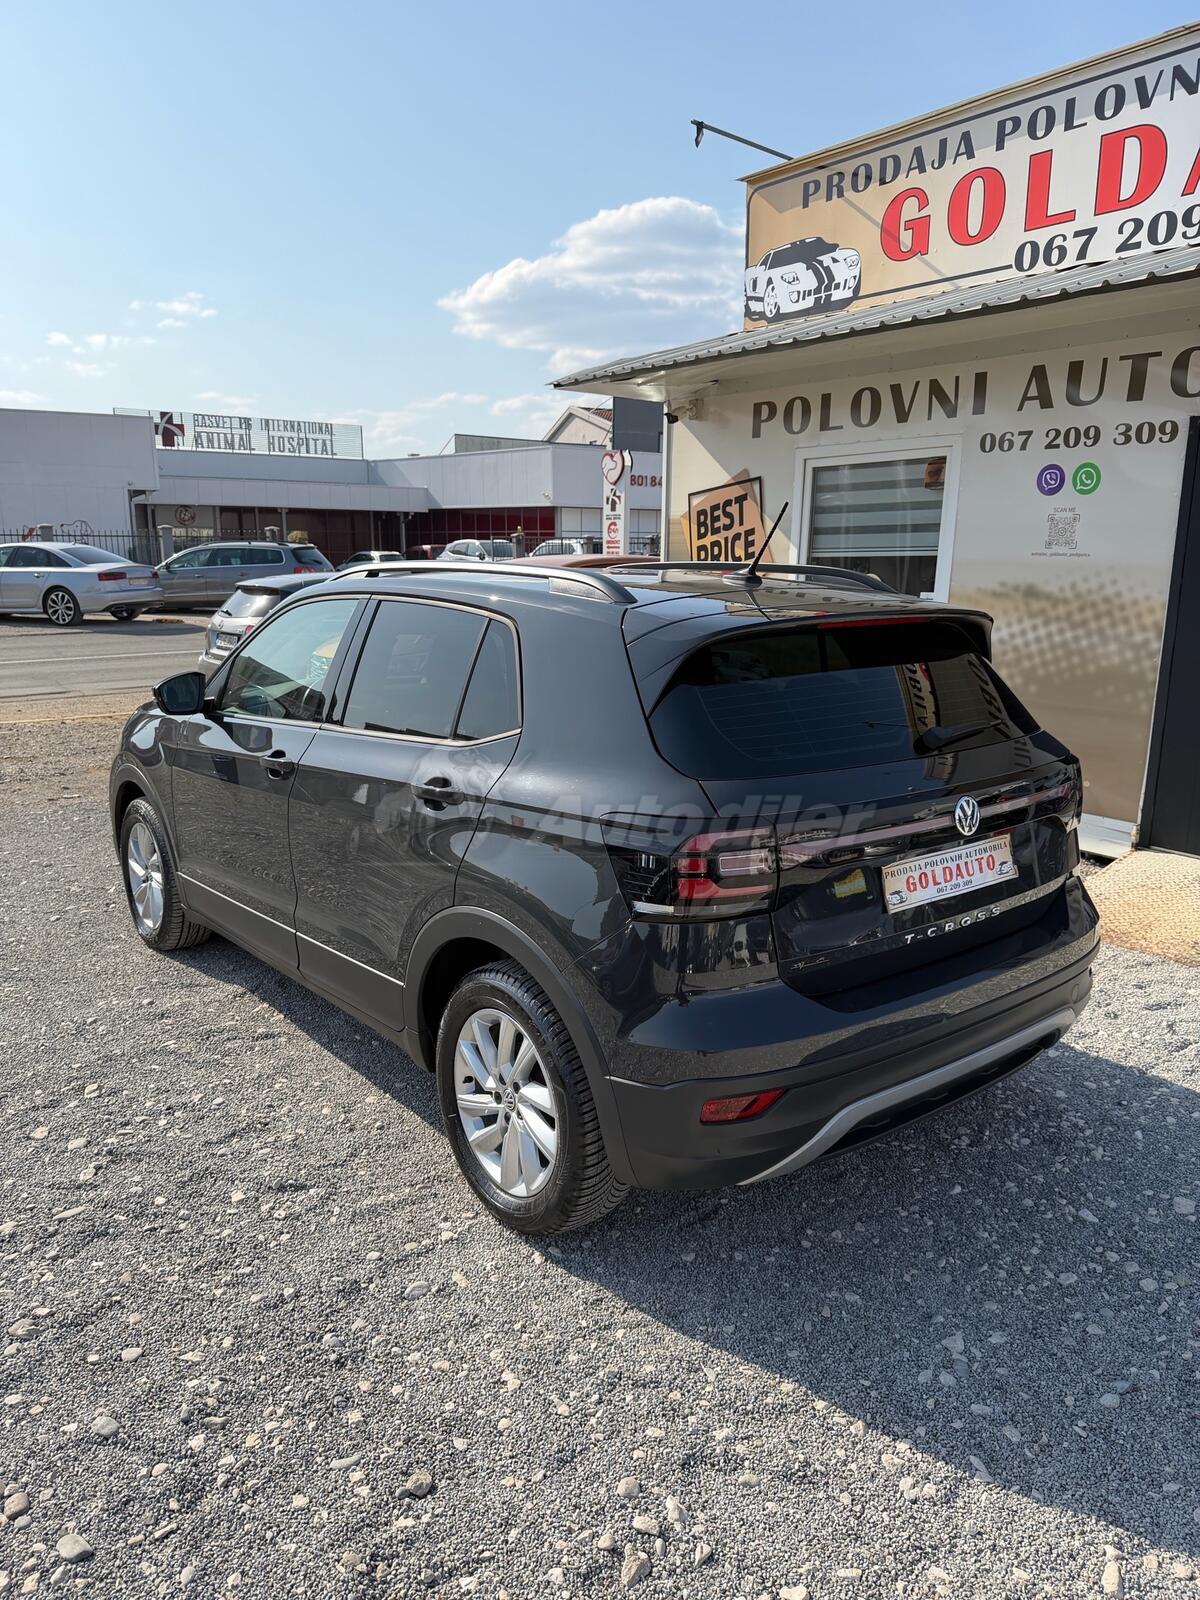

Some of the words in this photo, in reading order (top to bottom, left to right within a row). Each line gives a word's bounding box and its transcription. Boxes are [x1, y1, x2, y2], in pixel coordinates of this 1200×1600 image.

[802, 130, 976, 209] PRODAJA
[1014, 226, 1099, 273] 067
[1114, 203, 1200, 254] 209
[751, 371, 989, 439] POLOVNI
[1016, 345, 1200, 412] AUTO
[197, 431, 256, 451] ANIMAL
[268, 435, 338, 456] HOSPITAL
[260, 418, 336, 436] INTERNATIONAL
[979, 429, 1034, 454] 067
[1044, 425, 1101, 450] 209
[1113, 420, 1179, 446] 309
[696, 493, 748, 541] BEST
[884, 863, 922, 880] PRODAJA
[924, 853, 963, 869] POLOVNIH
[964, 842, 1008, 860] AUTOMOBILA
[905, 854, 996, 893] GOLDAUTO
[936, 884, 948, 894] 067
[949, 881, 961, 891] 209
[962, 878, 973, 888] 309
[904, 906, 1001, 945] T-CROSS
